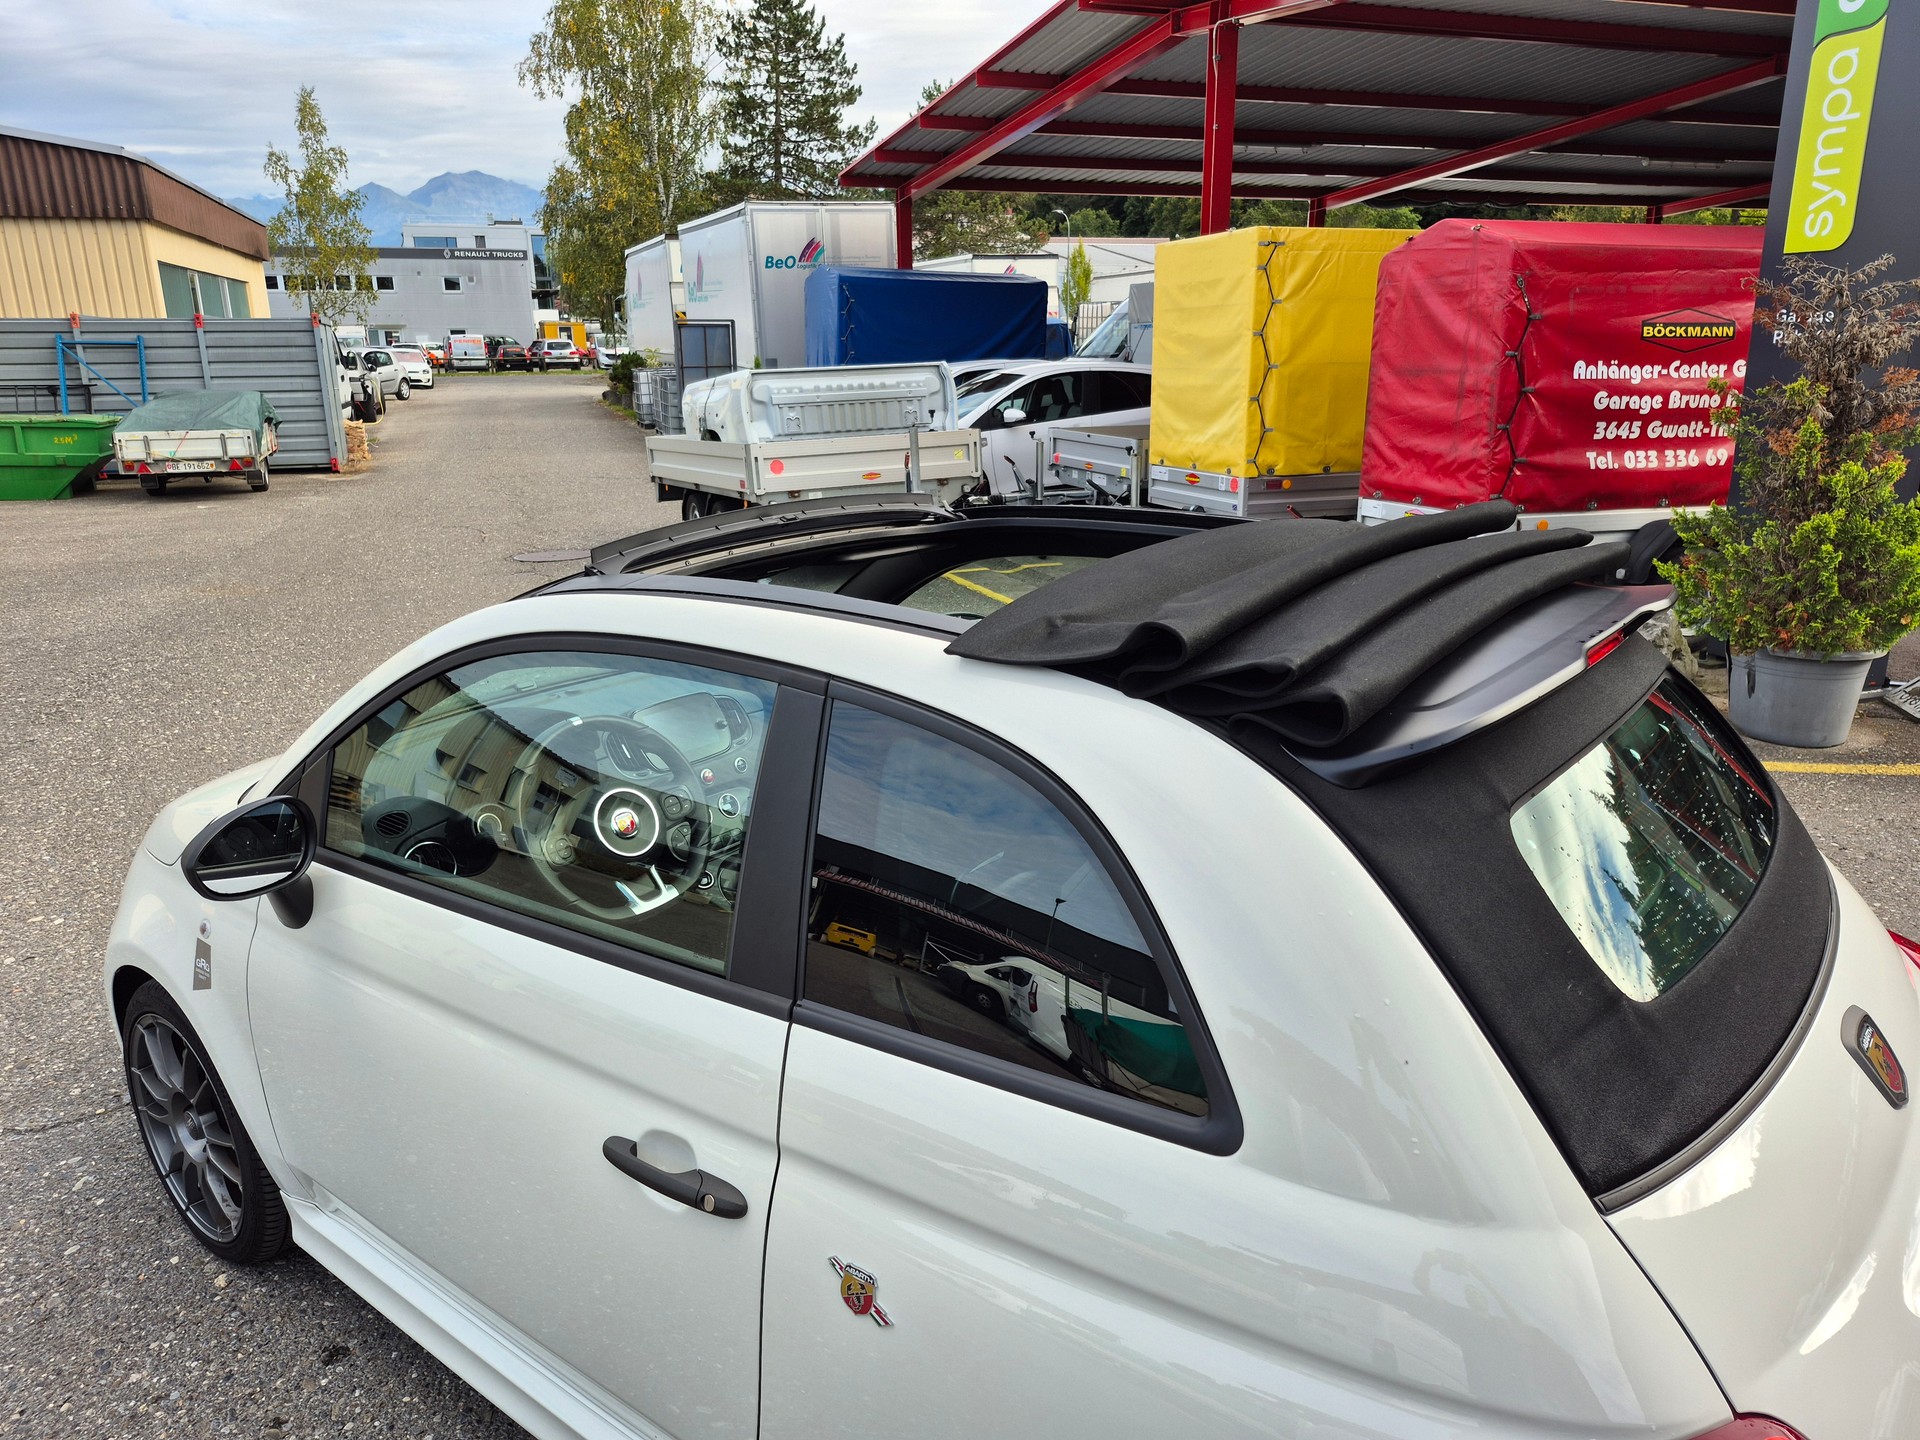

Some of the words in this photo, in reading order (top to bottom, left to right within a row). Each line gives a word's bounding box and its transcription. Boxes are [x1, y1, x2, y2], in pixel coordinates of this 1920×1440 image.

[1804, 47, 1860, 238] sympa
[764, 255, 797, 269] BeO
[1643, 323, 1734, 338] BÖCKMANN
[1573, 359, 1727, 384] Anhänger-Center
[1593, 391, 1663, 414] Garage
[1668, 390, 1721, 409] Bruno
[1593, 421, 1642, 440] 3645
[1586, 451, 1619, 470] Tel.
[1623, 450, 1659, 469] 033
[1664, 449, 1699, 468] 336
[1705, 448, 1729, 467] 69
[846, 1266, 873, 1284] ABARTH
